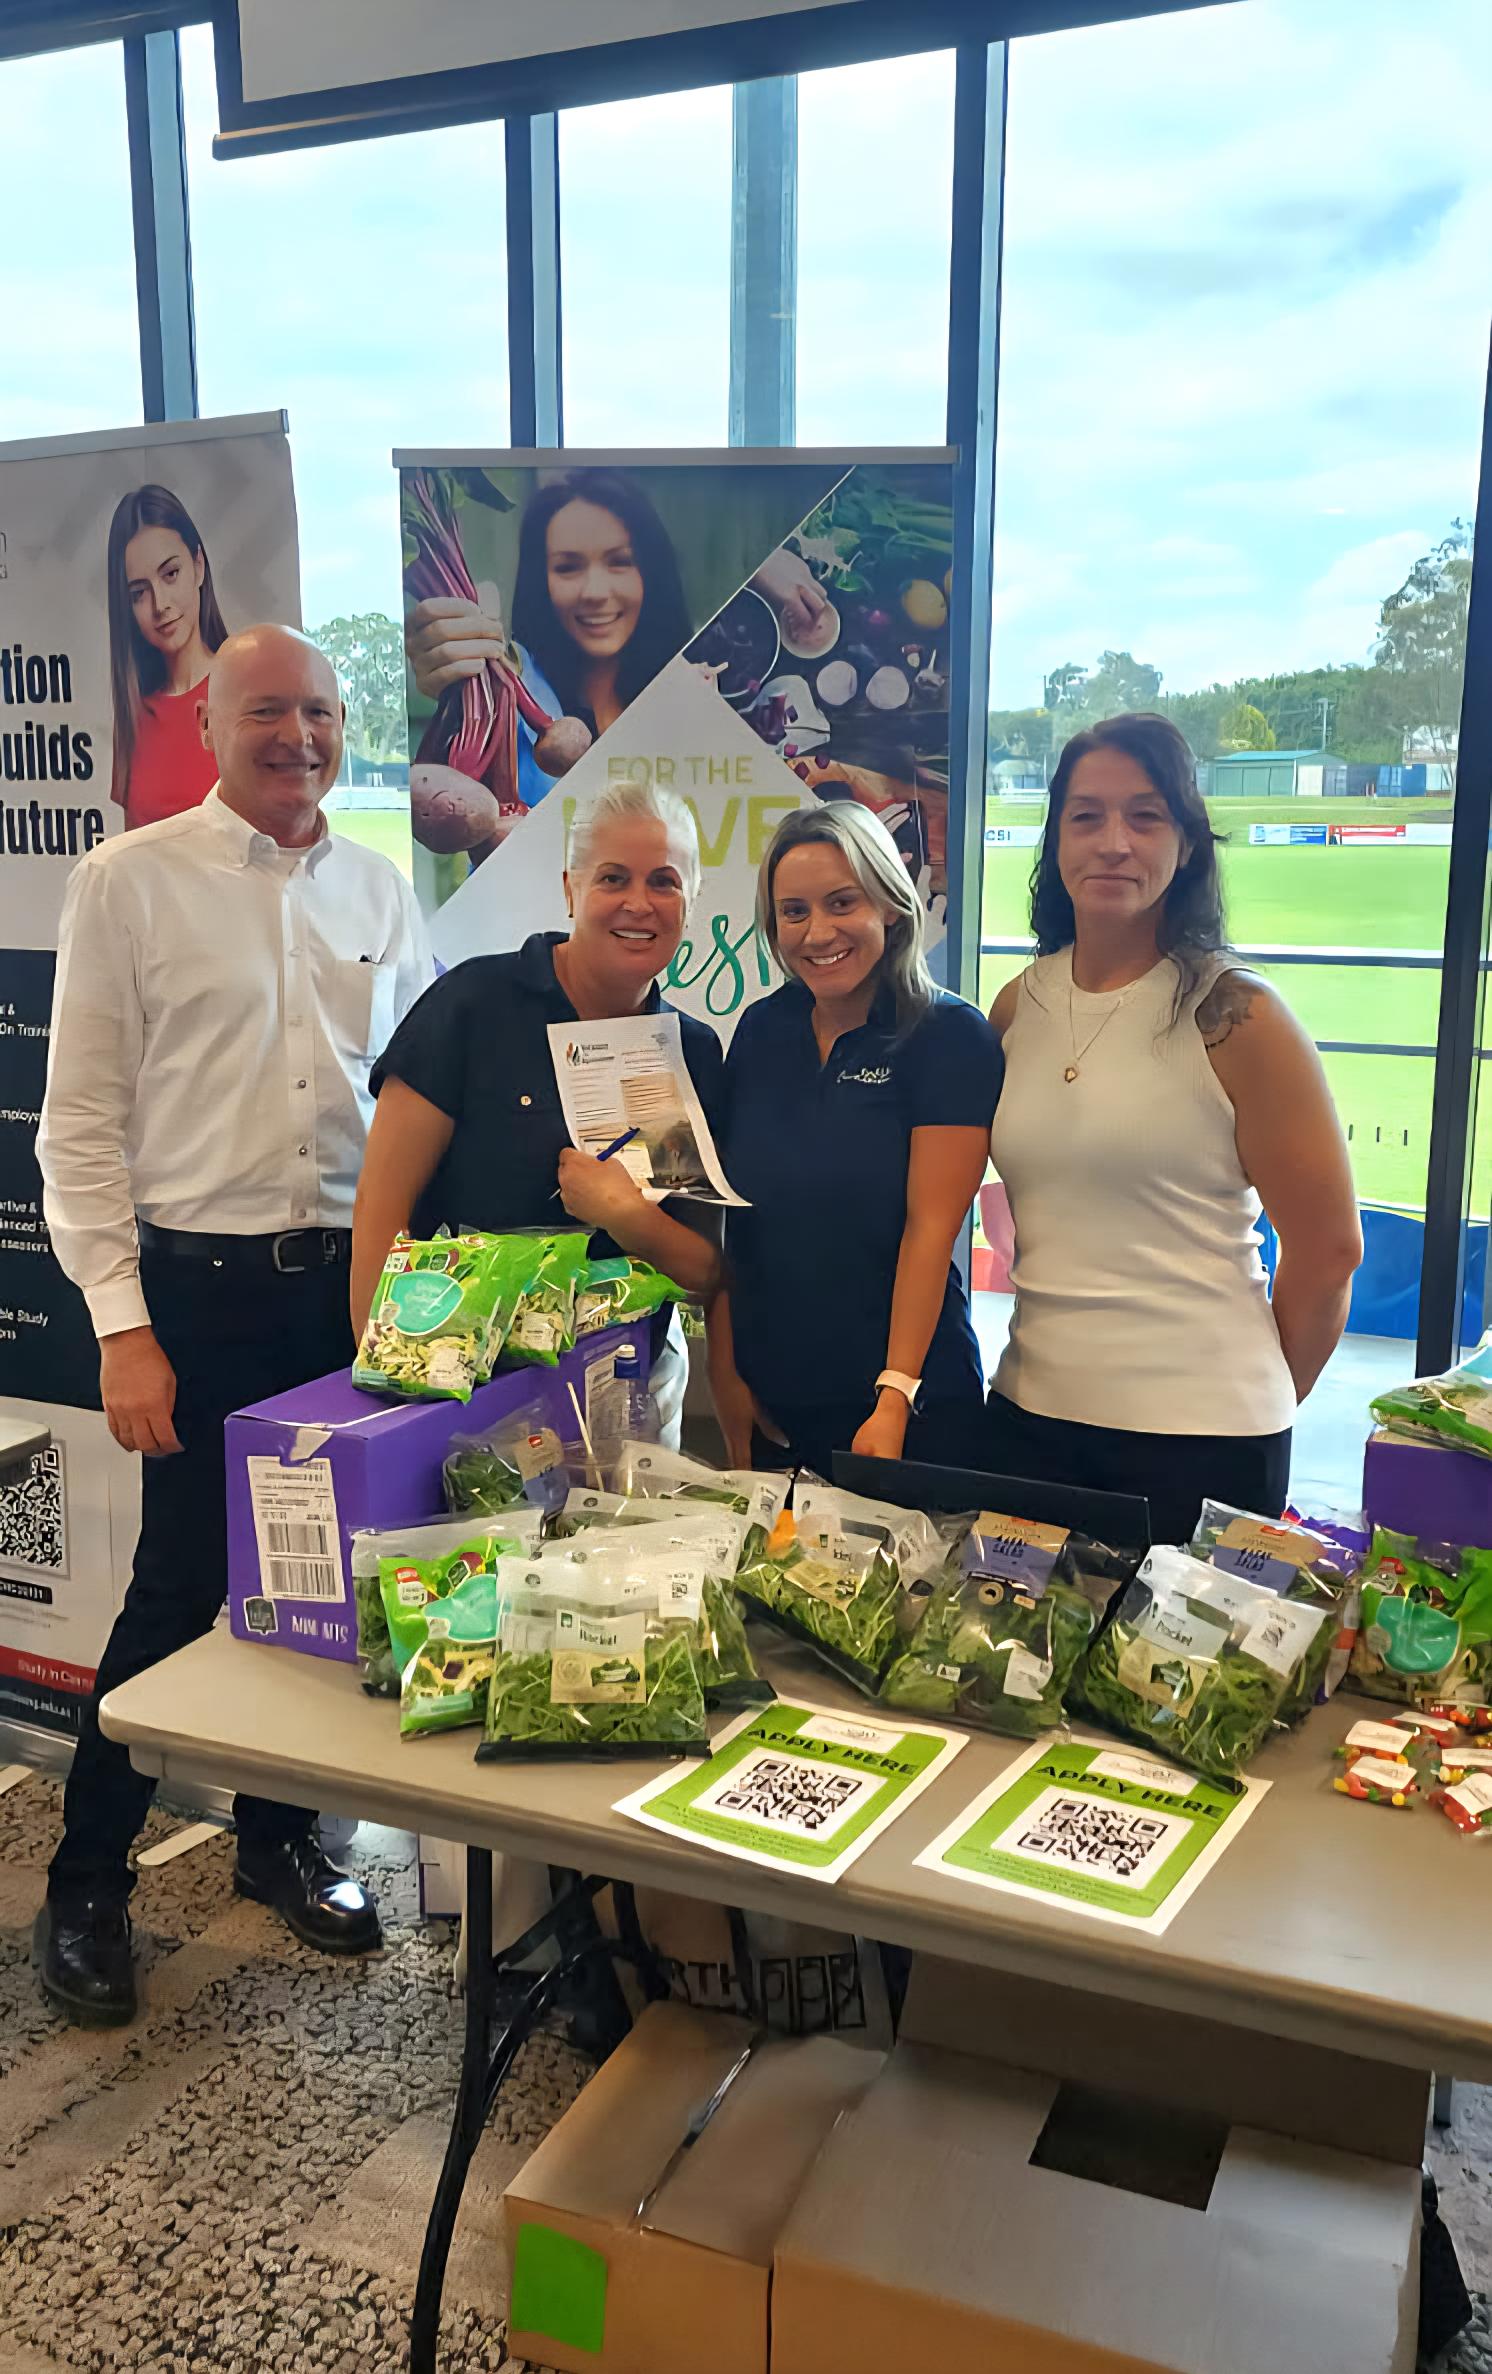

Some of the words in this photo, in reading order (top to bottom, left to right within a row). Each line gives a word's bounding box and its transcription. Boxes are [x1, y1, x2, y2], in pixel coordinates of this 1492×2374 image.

[0, 720, 94, 781] uilds
[607, 756, 675, 785] FOR
[684, 756, 753, 785] THE
[746, 1729, 834, 1754] APPLY
[841, 1749, 918, 1776] HERE
[1034, 1766, 1126, 1794] APPLY
[1140, 1790, 1225, 1818] HERE
